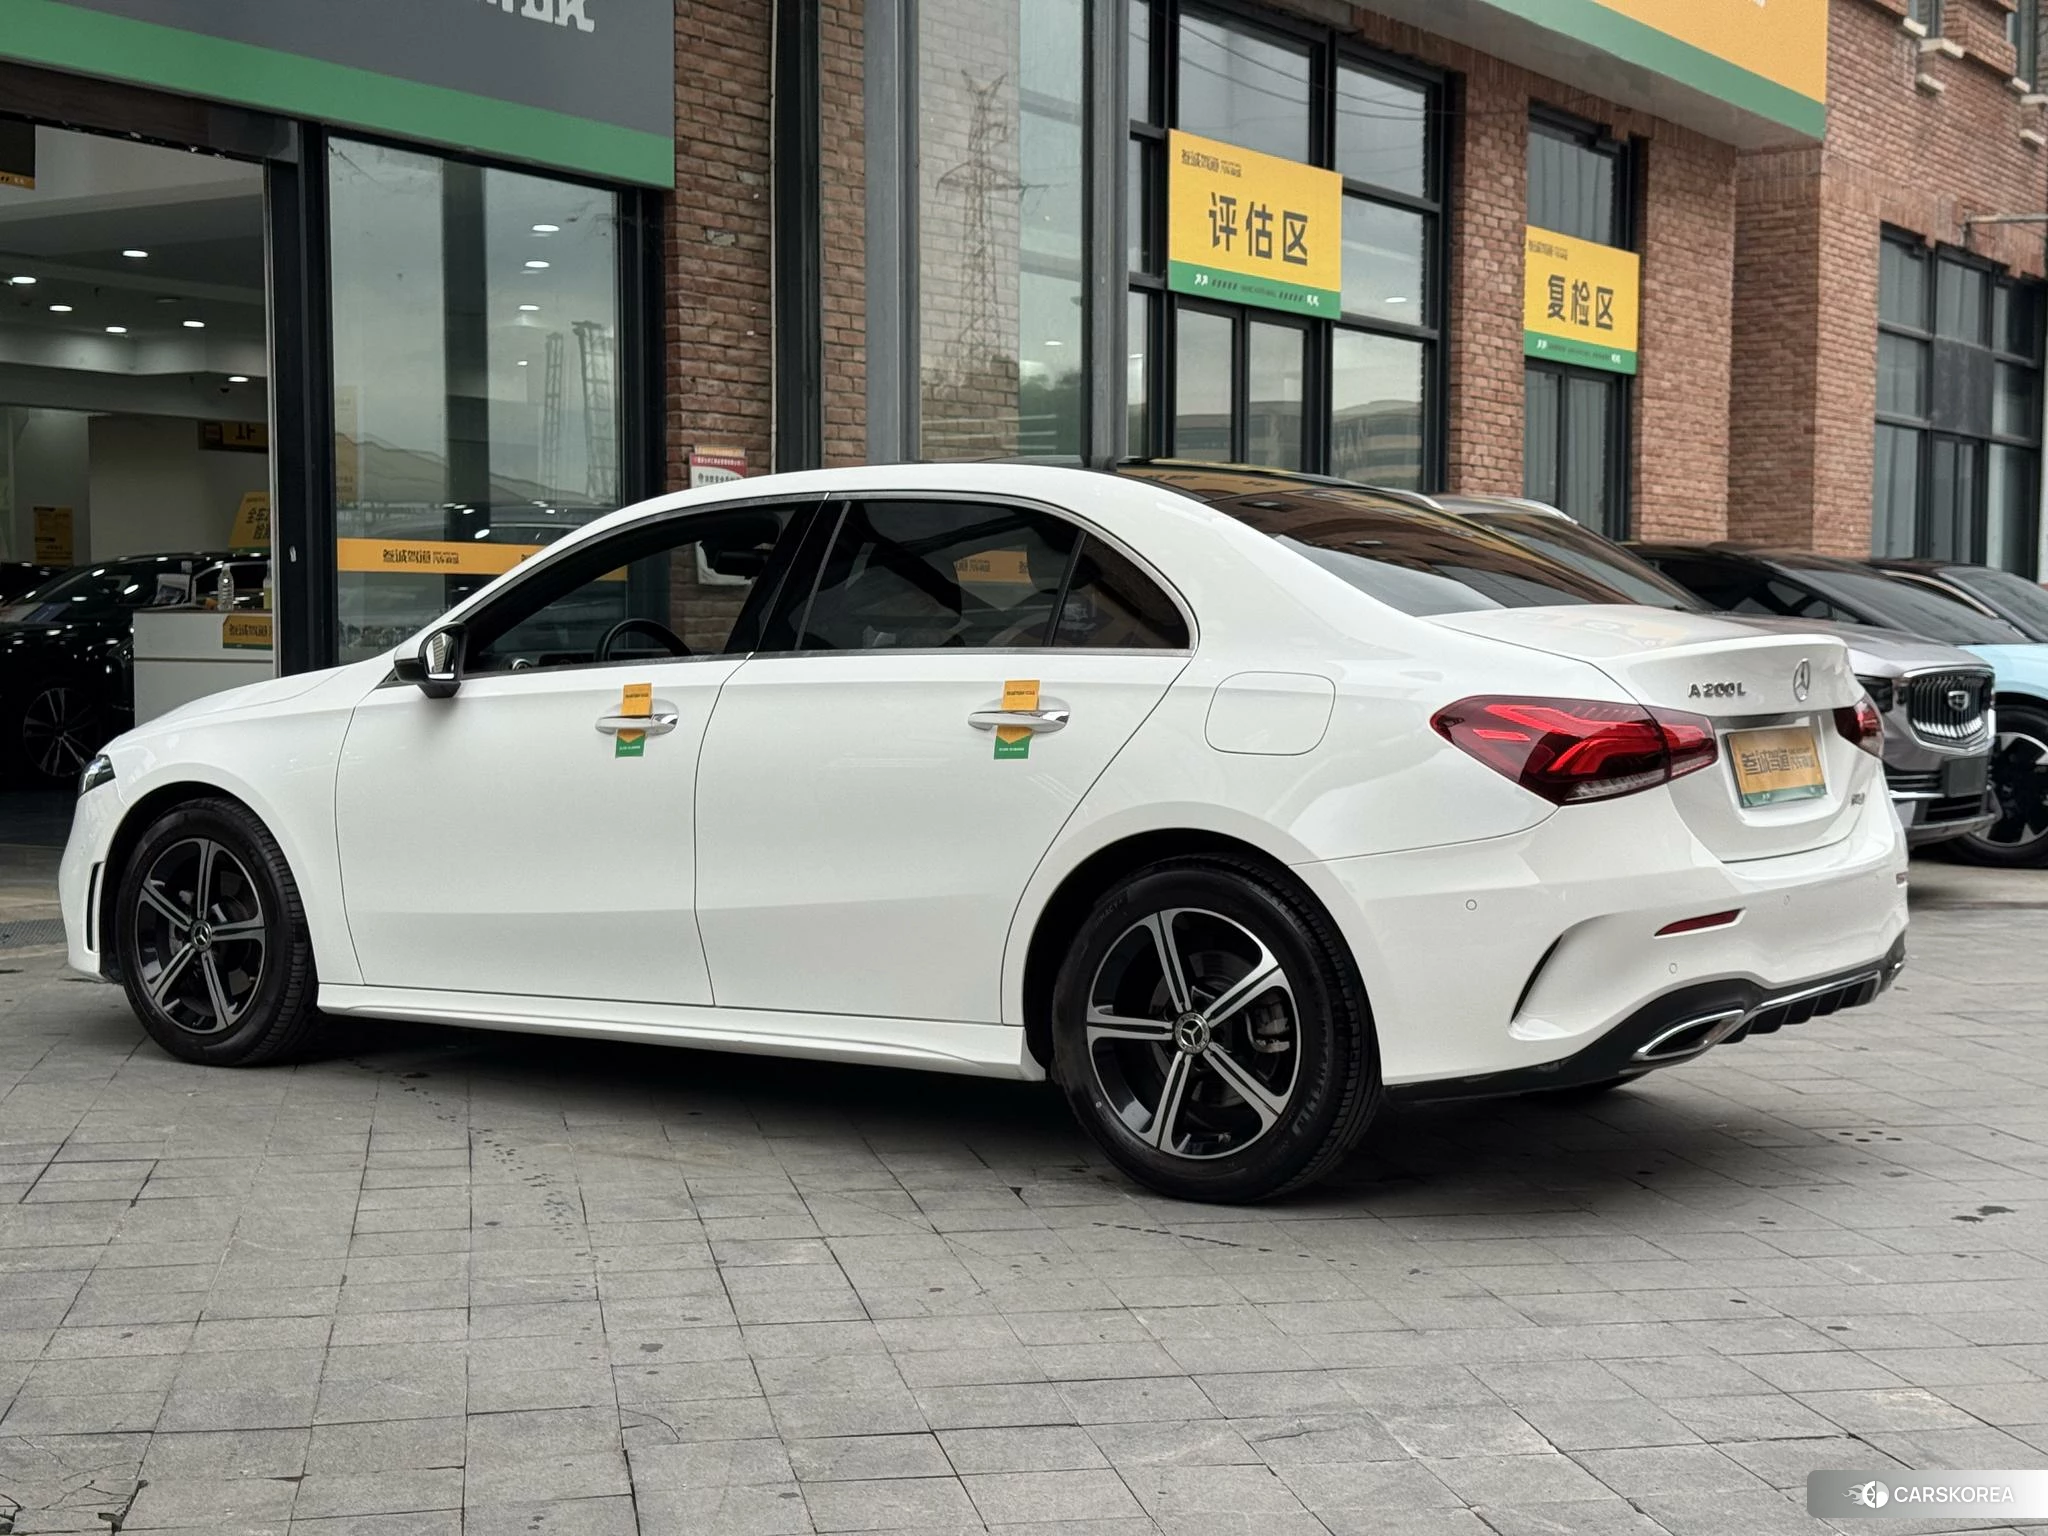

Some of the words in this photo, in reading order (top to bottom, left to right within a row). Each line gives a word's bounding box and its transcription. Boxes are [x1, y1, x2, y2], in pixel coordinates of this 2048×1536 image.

[1208, 191, 1308, 266] 评估区
[1547, 274, 1614, 331] 复检区
